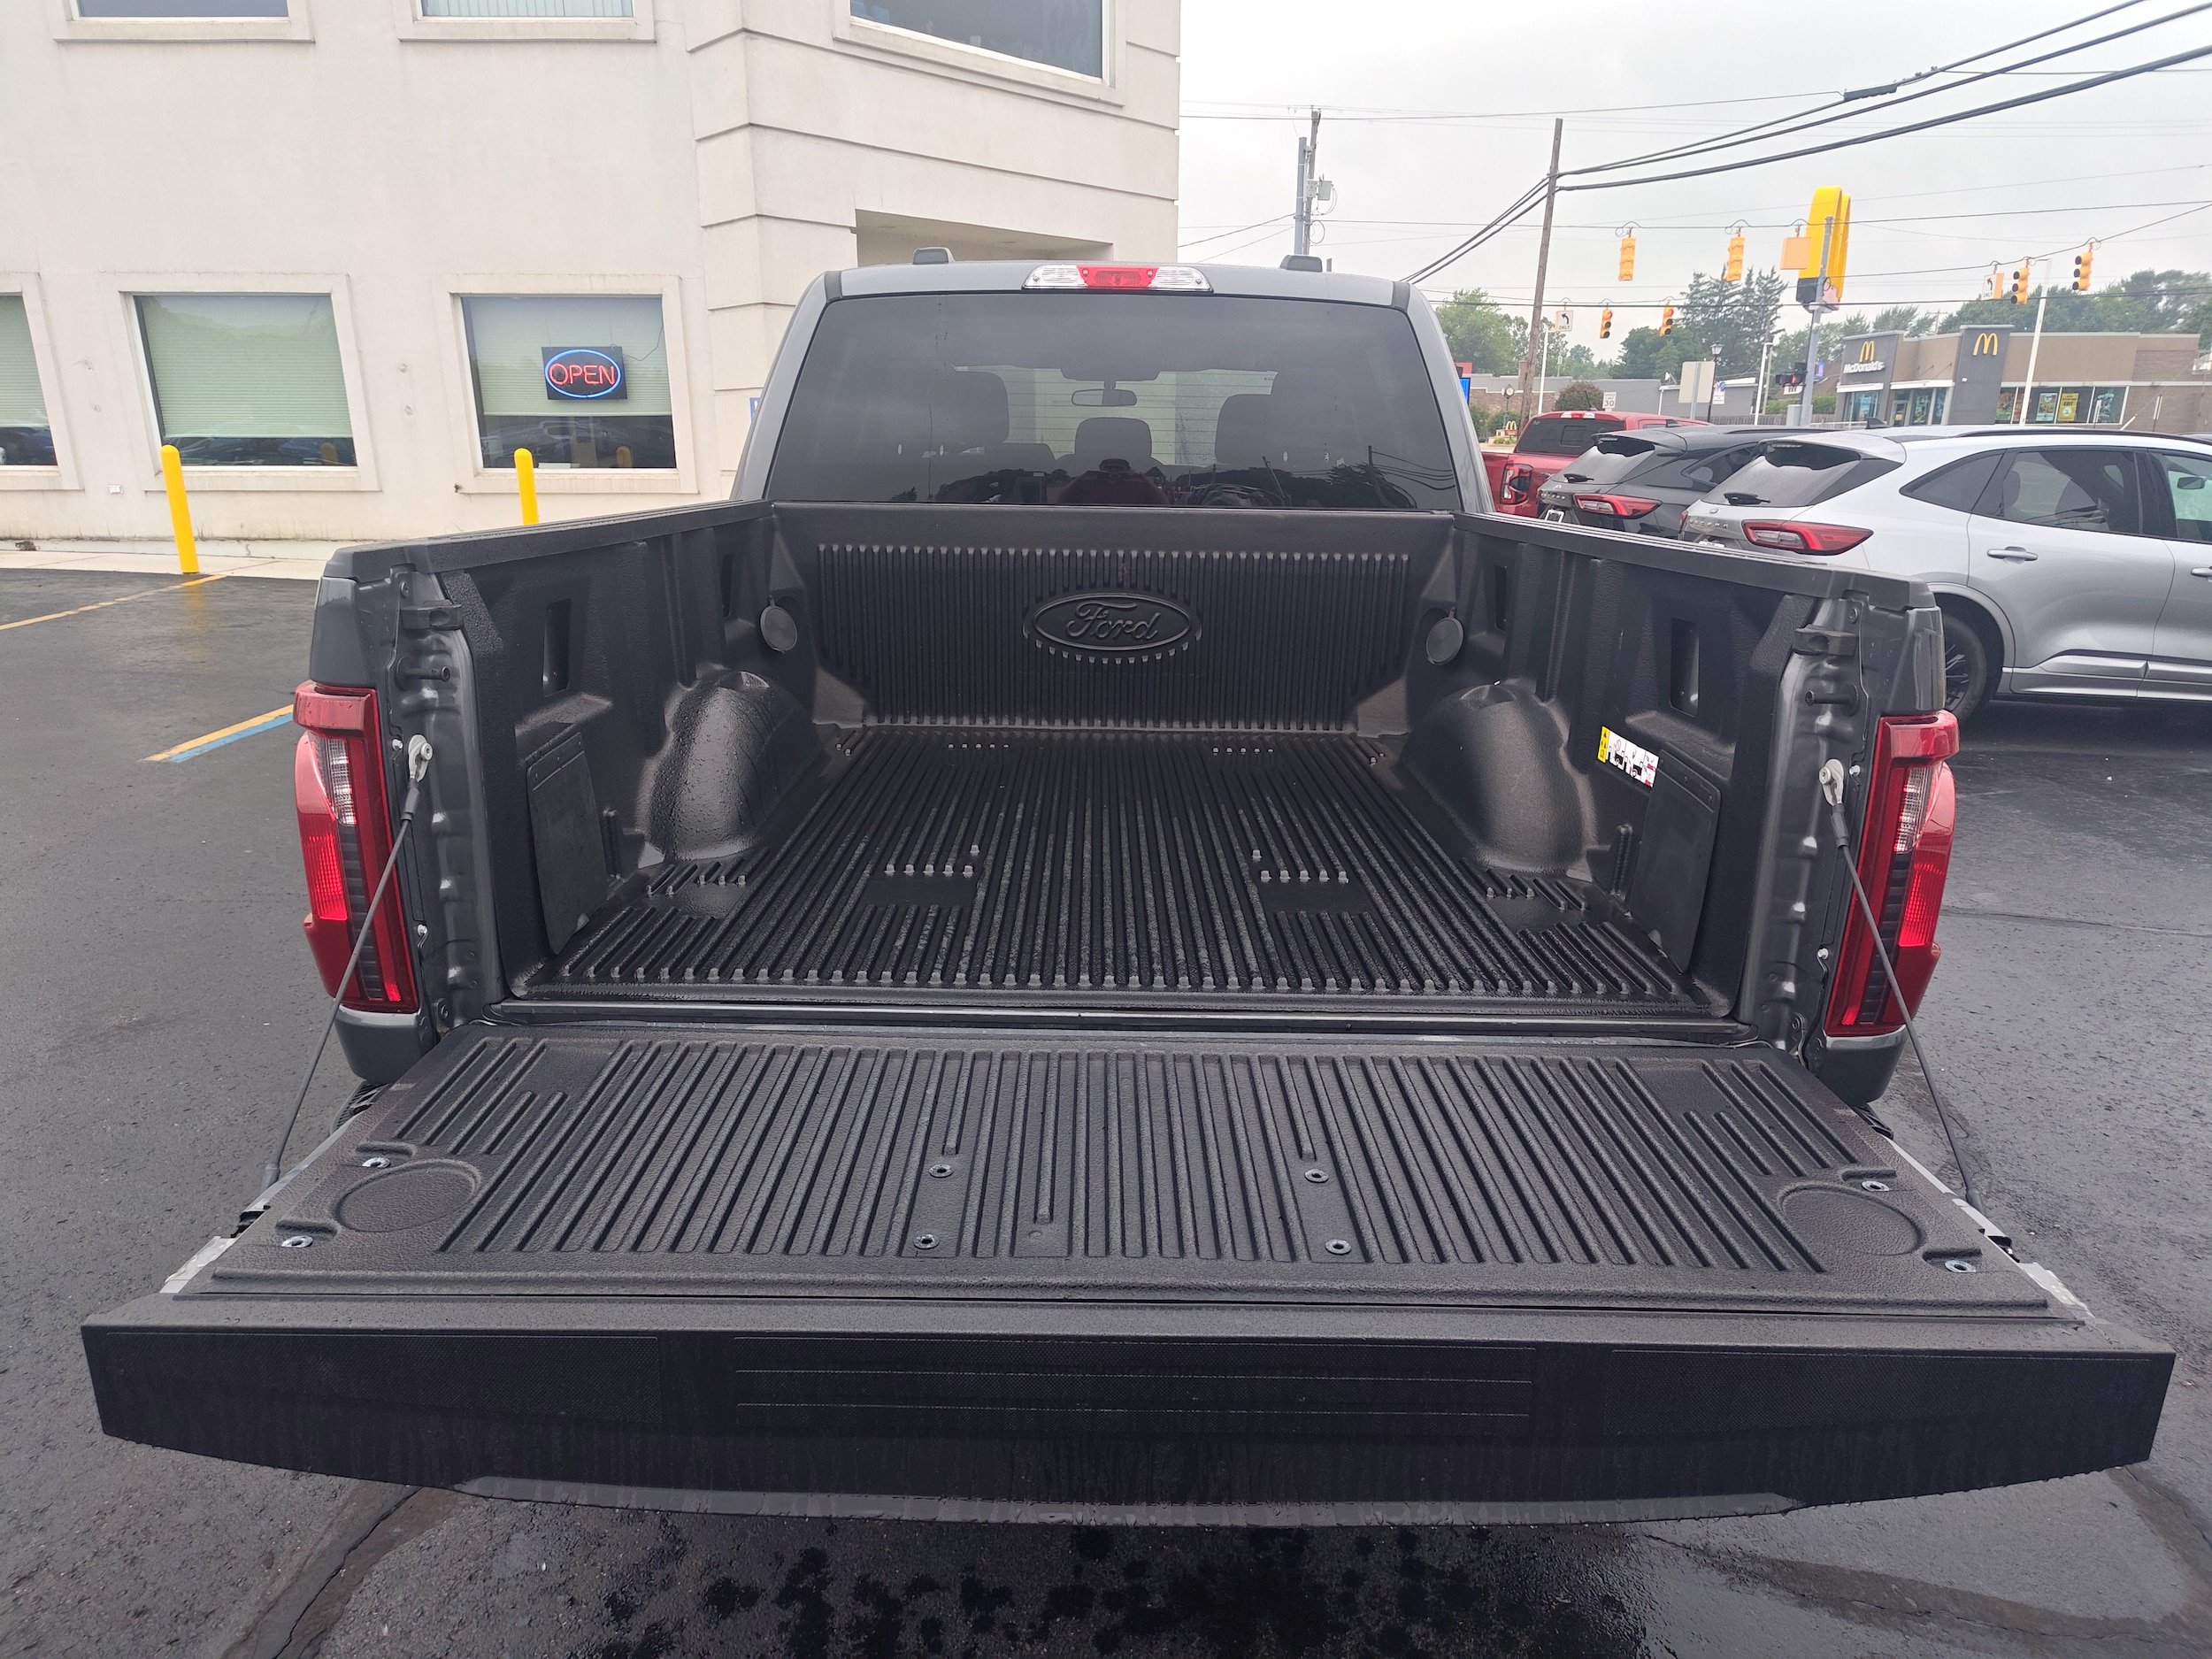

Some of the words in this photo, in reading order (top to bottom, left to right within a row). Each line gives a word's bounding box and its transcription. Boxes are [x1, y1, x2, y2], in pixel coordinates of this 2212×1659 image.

[549, 364, 616, 386] OPEN
[1843, 360, 1885, 373] McDonald's
[1065, 600, 1161, 641] Ford
